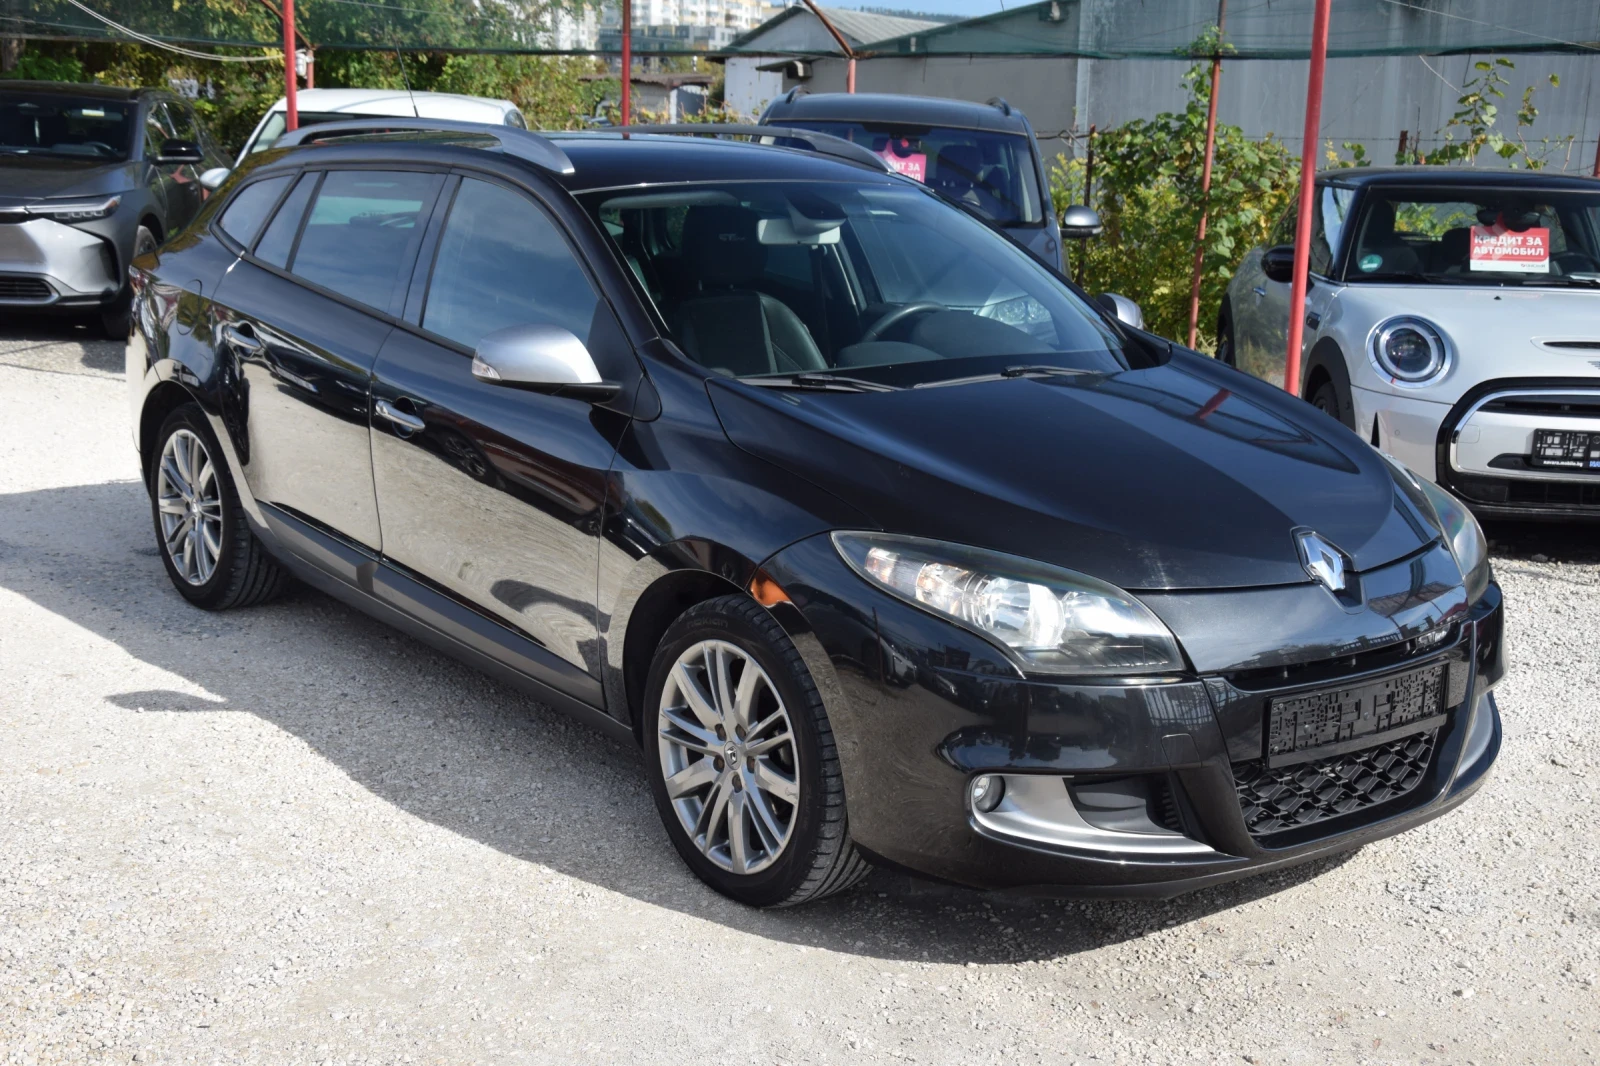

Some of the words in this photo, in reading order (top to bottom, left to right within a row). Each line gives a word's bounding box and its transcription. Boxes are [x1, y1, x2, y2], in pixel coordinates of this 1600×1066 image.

[907, 162, 920, 171] ЗА
[1474, 235, 1524, 246] КРЕДИТ
[1526, 236, 1542, 246] ЗА
[1473, 246, 1544, 256] АВТОМОБИЛ
